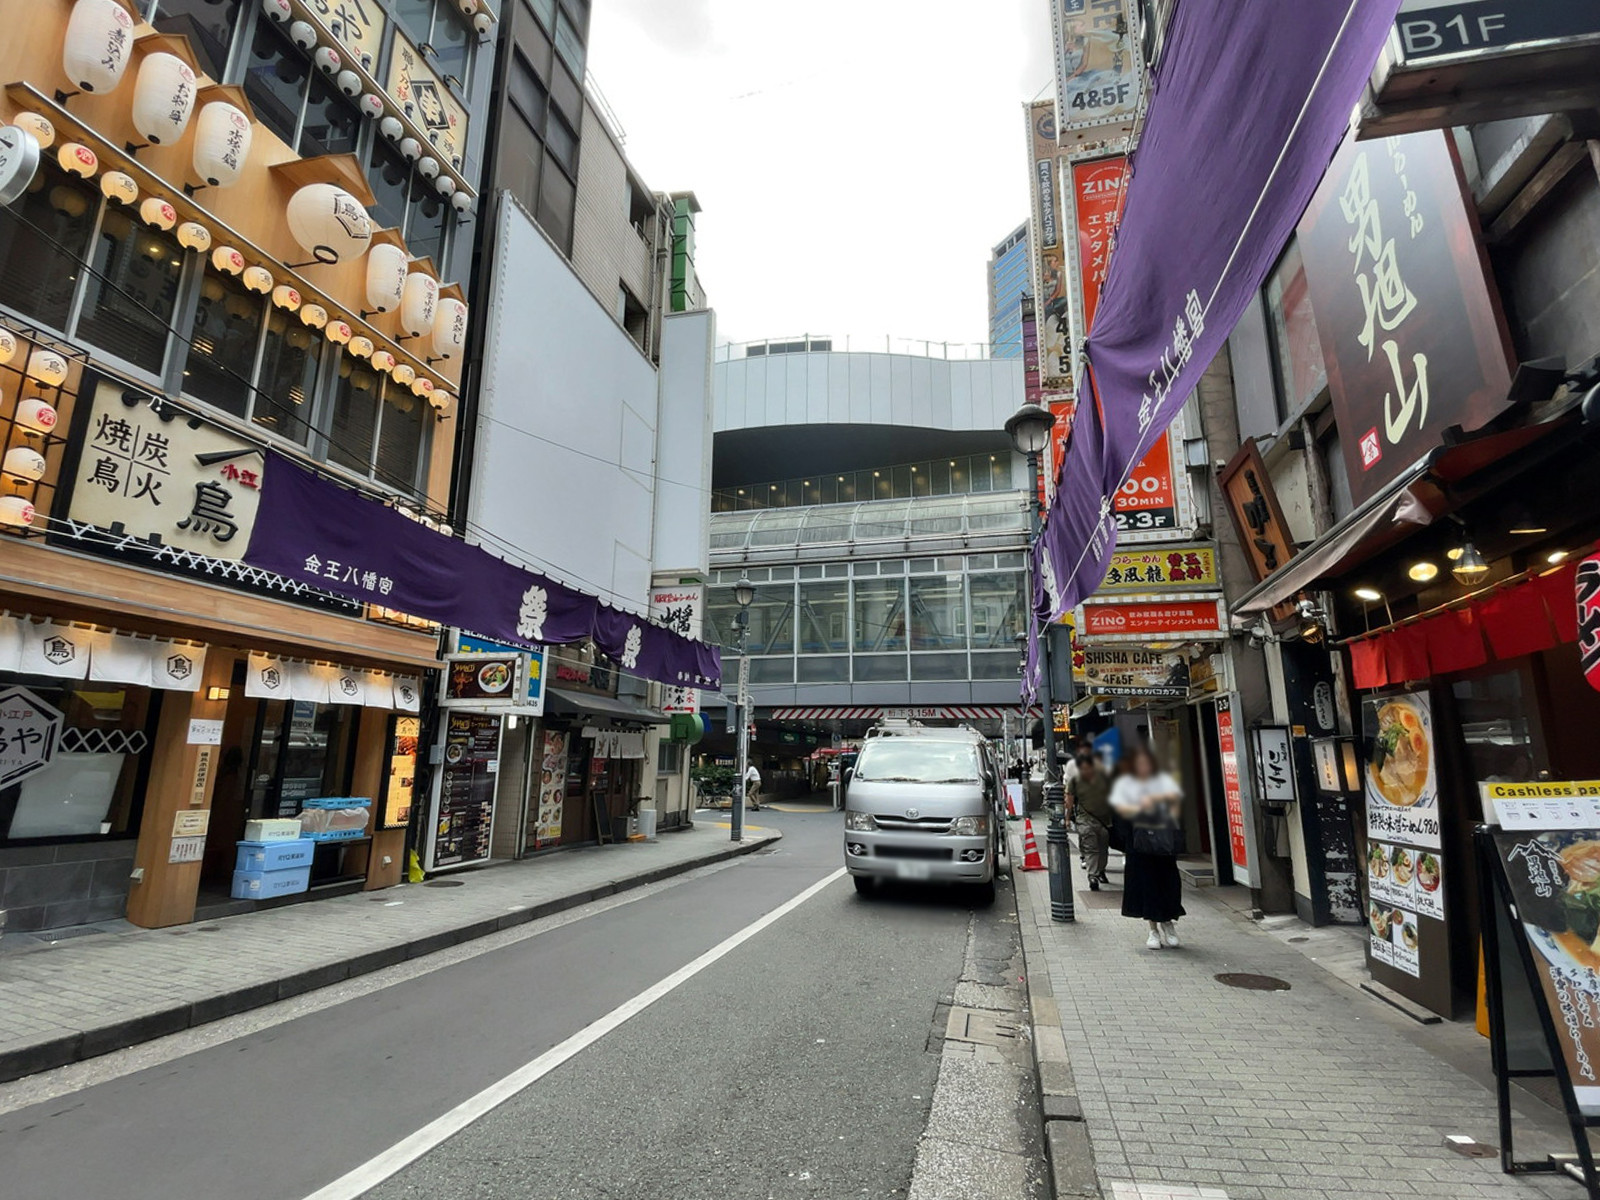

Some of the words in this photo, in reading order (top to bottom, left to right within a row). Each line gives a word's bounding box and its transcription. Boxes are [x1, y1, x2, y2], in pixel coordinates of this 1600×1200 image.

[1401, 13, 1506, 53] B1F
[1071, 83, 1130, 111] 4&5F
[87, 413, 134, 495] 焼鳥
[132, 432, 171, 507] 炭火
[221, 463, 263, 493] 小江
[1119, 476, 1159, 495] 00
[176, 480, 239, 543] 鳥
[1117, 496, 1164, 508] 30MIN
[303, 553, 394, 595] 金王八幡宮
[1105, 565, 1166, 586] 多風龍
[1091, 616, 1126, 626] ZINO
[1086, 651, 1129, 665] SHISHA
[1132, 652, 1164, 665] CAFE
[1103, 674, 1134, 685] 4F&5F
[1495, 786, 1572, 797] Cashless
